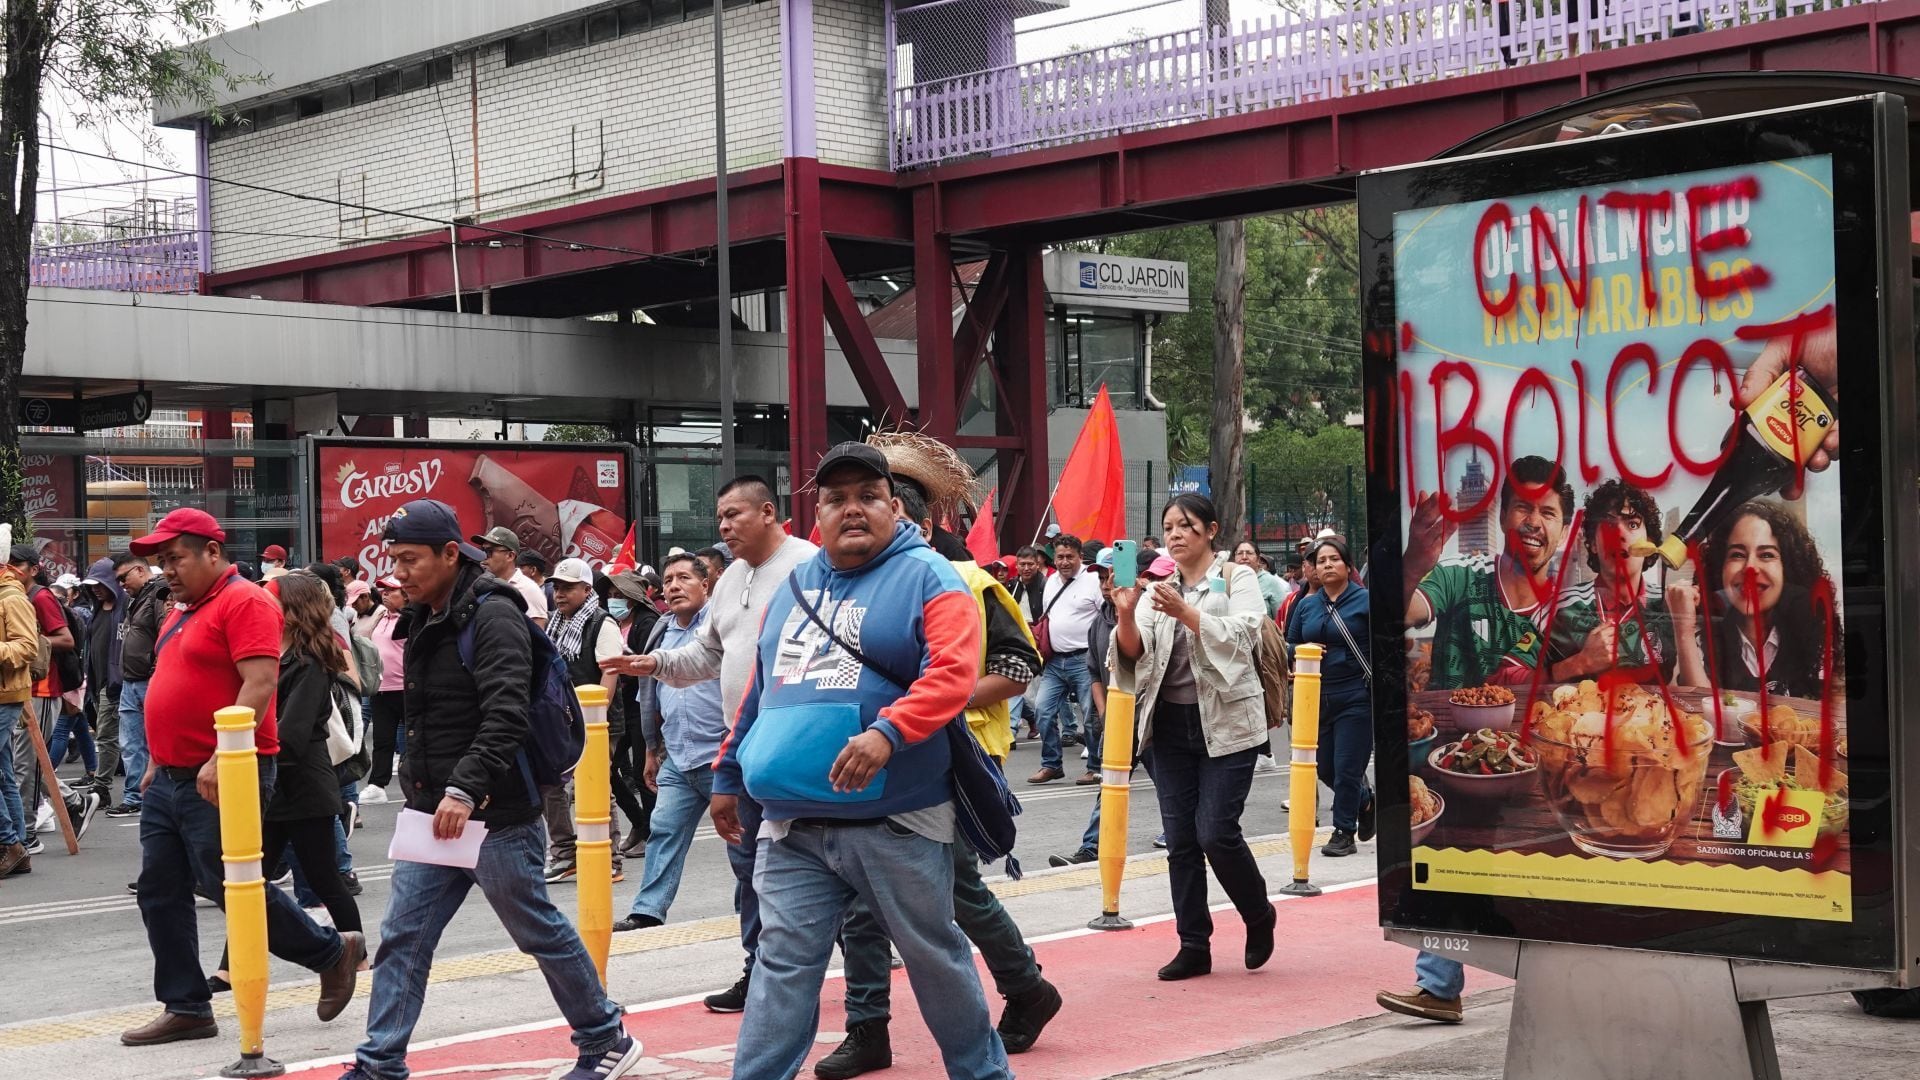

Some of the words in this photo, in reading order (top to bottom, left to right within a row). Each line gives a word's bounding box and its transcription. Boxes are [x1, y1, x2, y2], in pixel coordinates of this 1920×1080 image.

[1473, 175, 1772, 320] CNTE
[1100, 263, 1124, 284] CD.
[1127, 265, 1184, 289] JARDÍN
[1696, 846, 1745, 856] SAZONADOR
[1748, 848, 1777, 858] OFICIAL
[1793, 851, 1803, 859] LA
[1423, 936, 1440, 949] 02
[1444, 938, 1470, 952] 032
